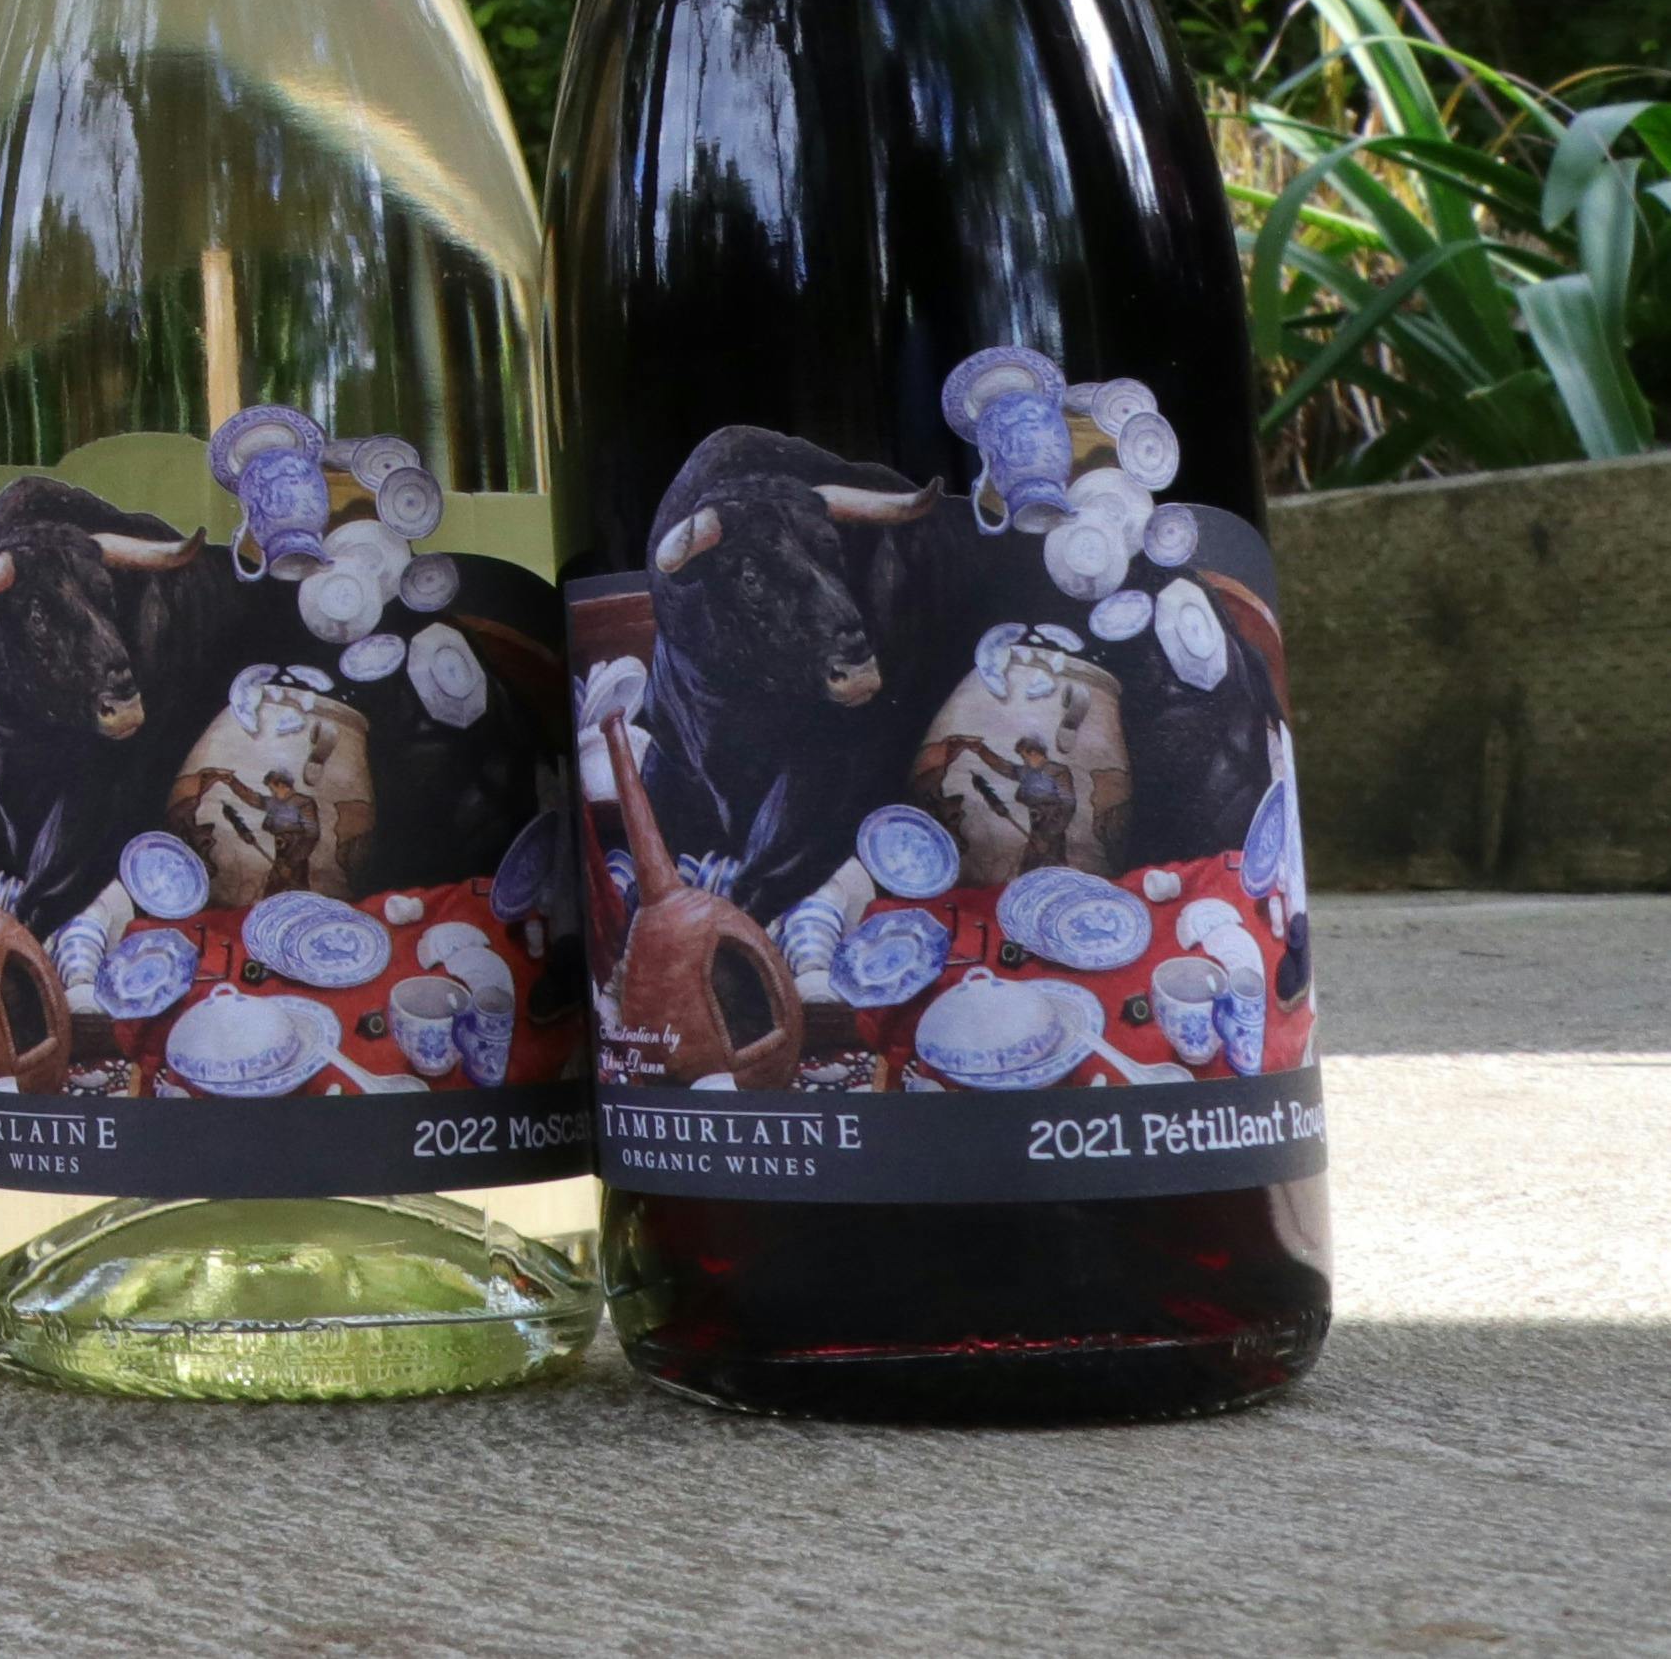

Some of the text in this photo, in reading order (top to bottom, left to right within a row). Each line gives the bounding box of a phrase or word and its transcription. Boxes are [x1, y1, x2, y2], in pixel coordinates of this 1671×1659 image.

[413, 1115, 498, 1157] 2022
[602, 1103, 862, 1150] TAMBURLAINE
[1028, 1113, 1131, 1160] 2021
[1140, 1099, 1286, 1157] Pétillant
[9, 1152, 80, 1174] WINES
[622, 1148, 817, 1177] ORGANIC WINES
